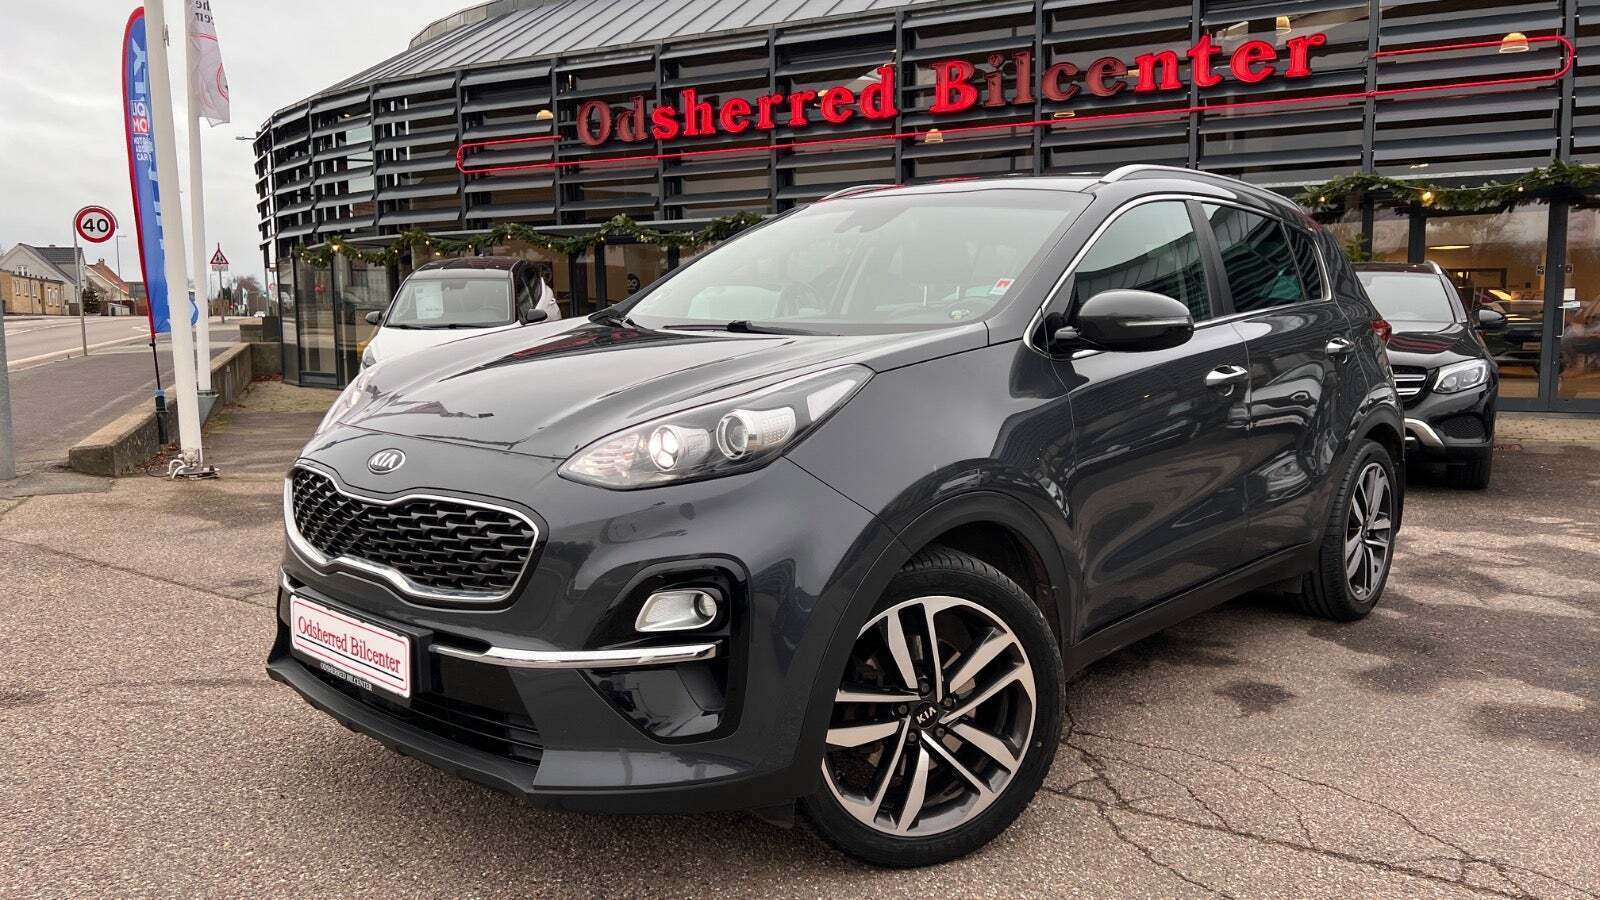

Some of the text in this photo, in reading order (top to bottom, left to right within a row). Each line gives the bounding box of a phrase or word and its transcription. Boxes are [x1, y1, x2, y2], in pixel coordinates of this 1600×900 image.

[576, 32, 1328, 146] Odsherred Bilcenter
[83, 218, 109, 232] 40
[371, 452, 398, 468] KIA
[298, 616, 400, 674] Odsherred Bilcenter
[916, 706, 937, 724] KIA
